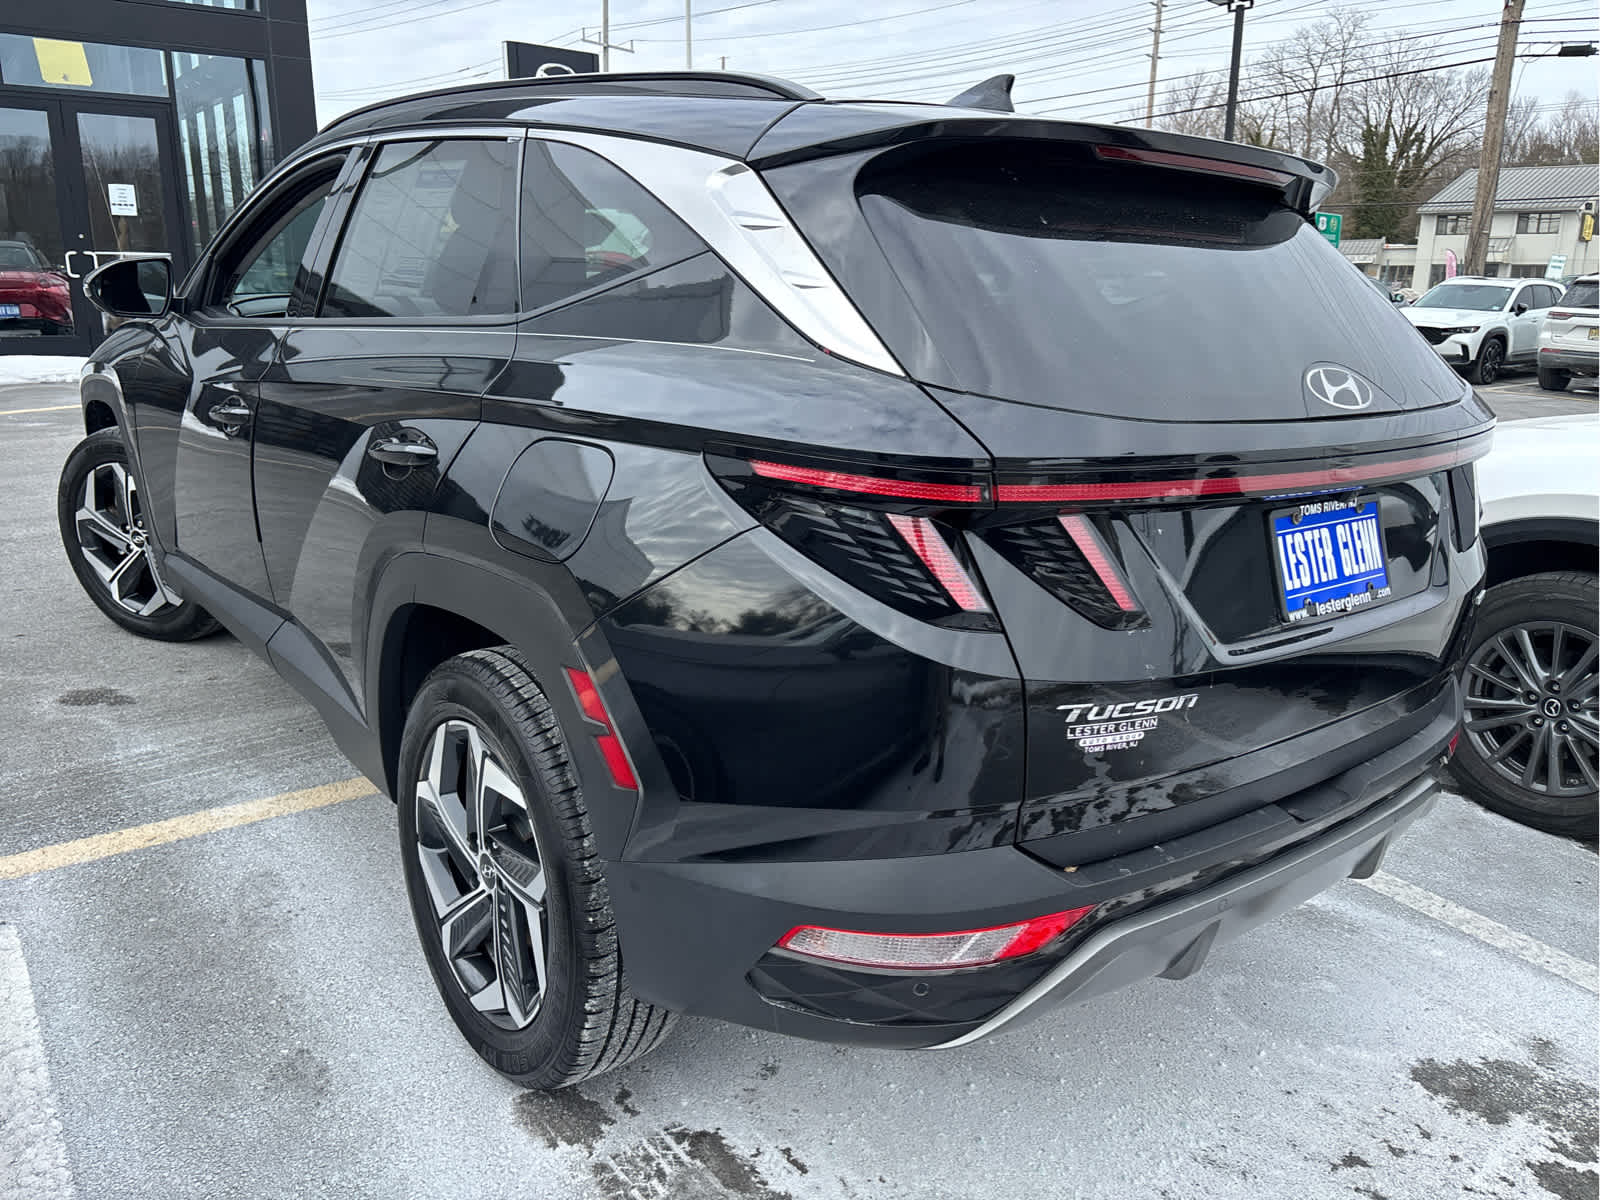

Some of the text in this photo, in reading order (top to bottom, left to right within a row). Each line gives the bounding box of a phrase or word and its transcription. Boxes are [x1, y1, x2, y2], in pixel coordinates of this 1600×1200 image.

[1299, 502, 1322, 516] TOMS
[1277, 518, 1383, 591] LESTER GLENN
[1066, 718, 1158, 737] LESTER GLENN
[1084, 744, 1105, 753] TOMS
